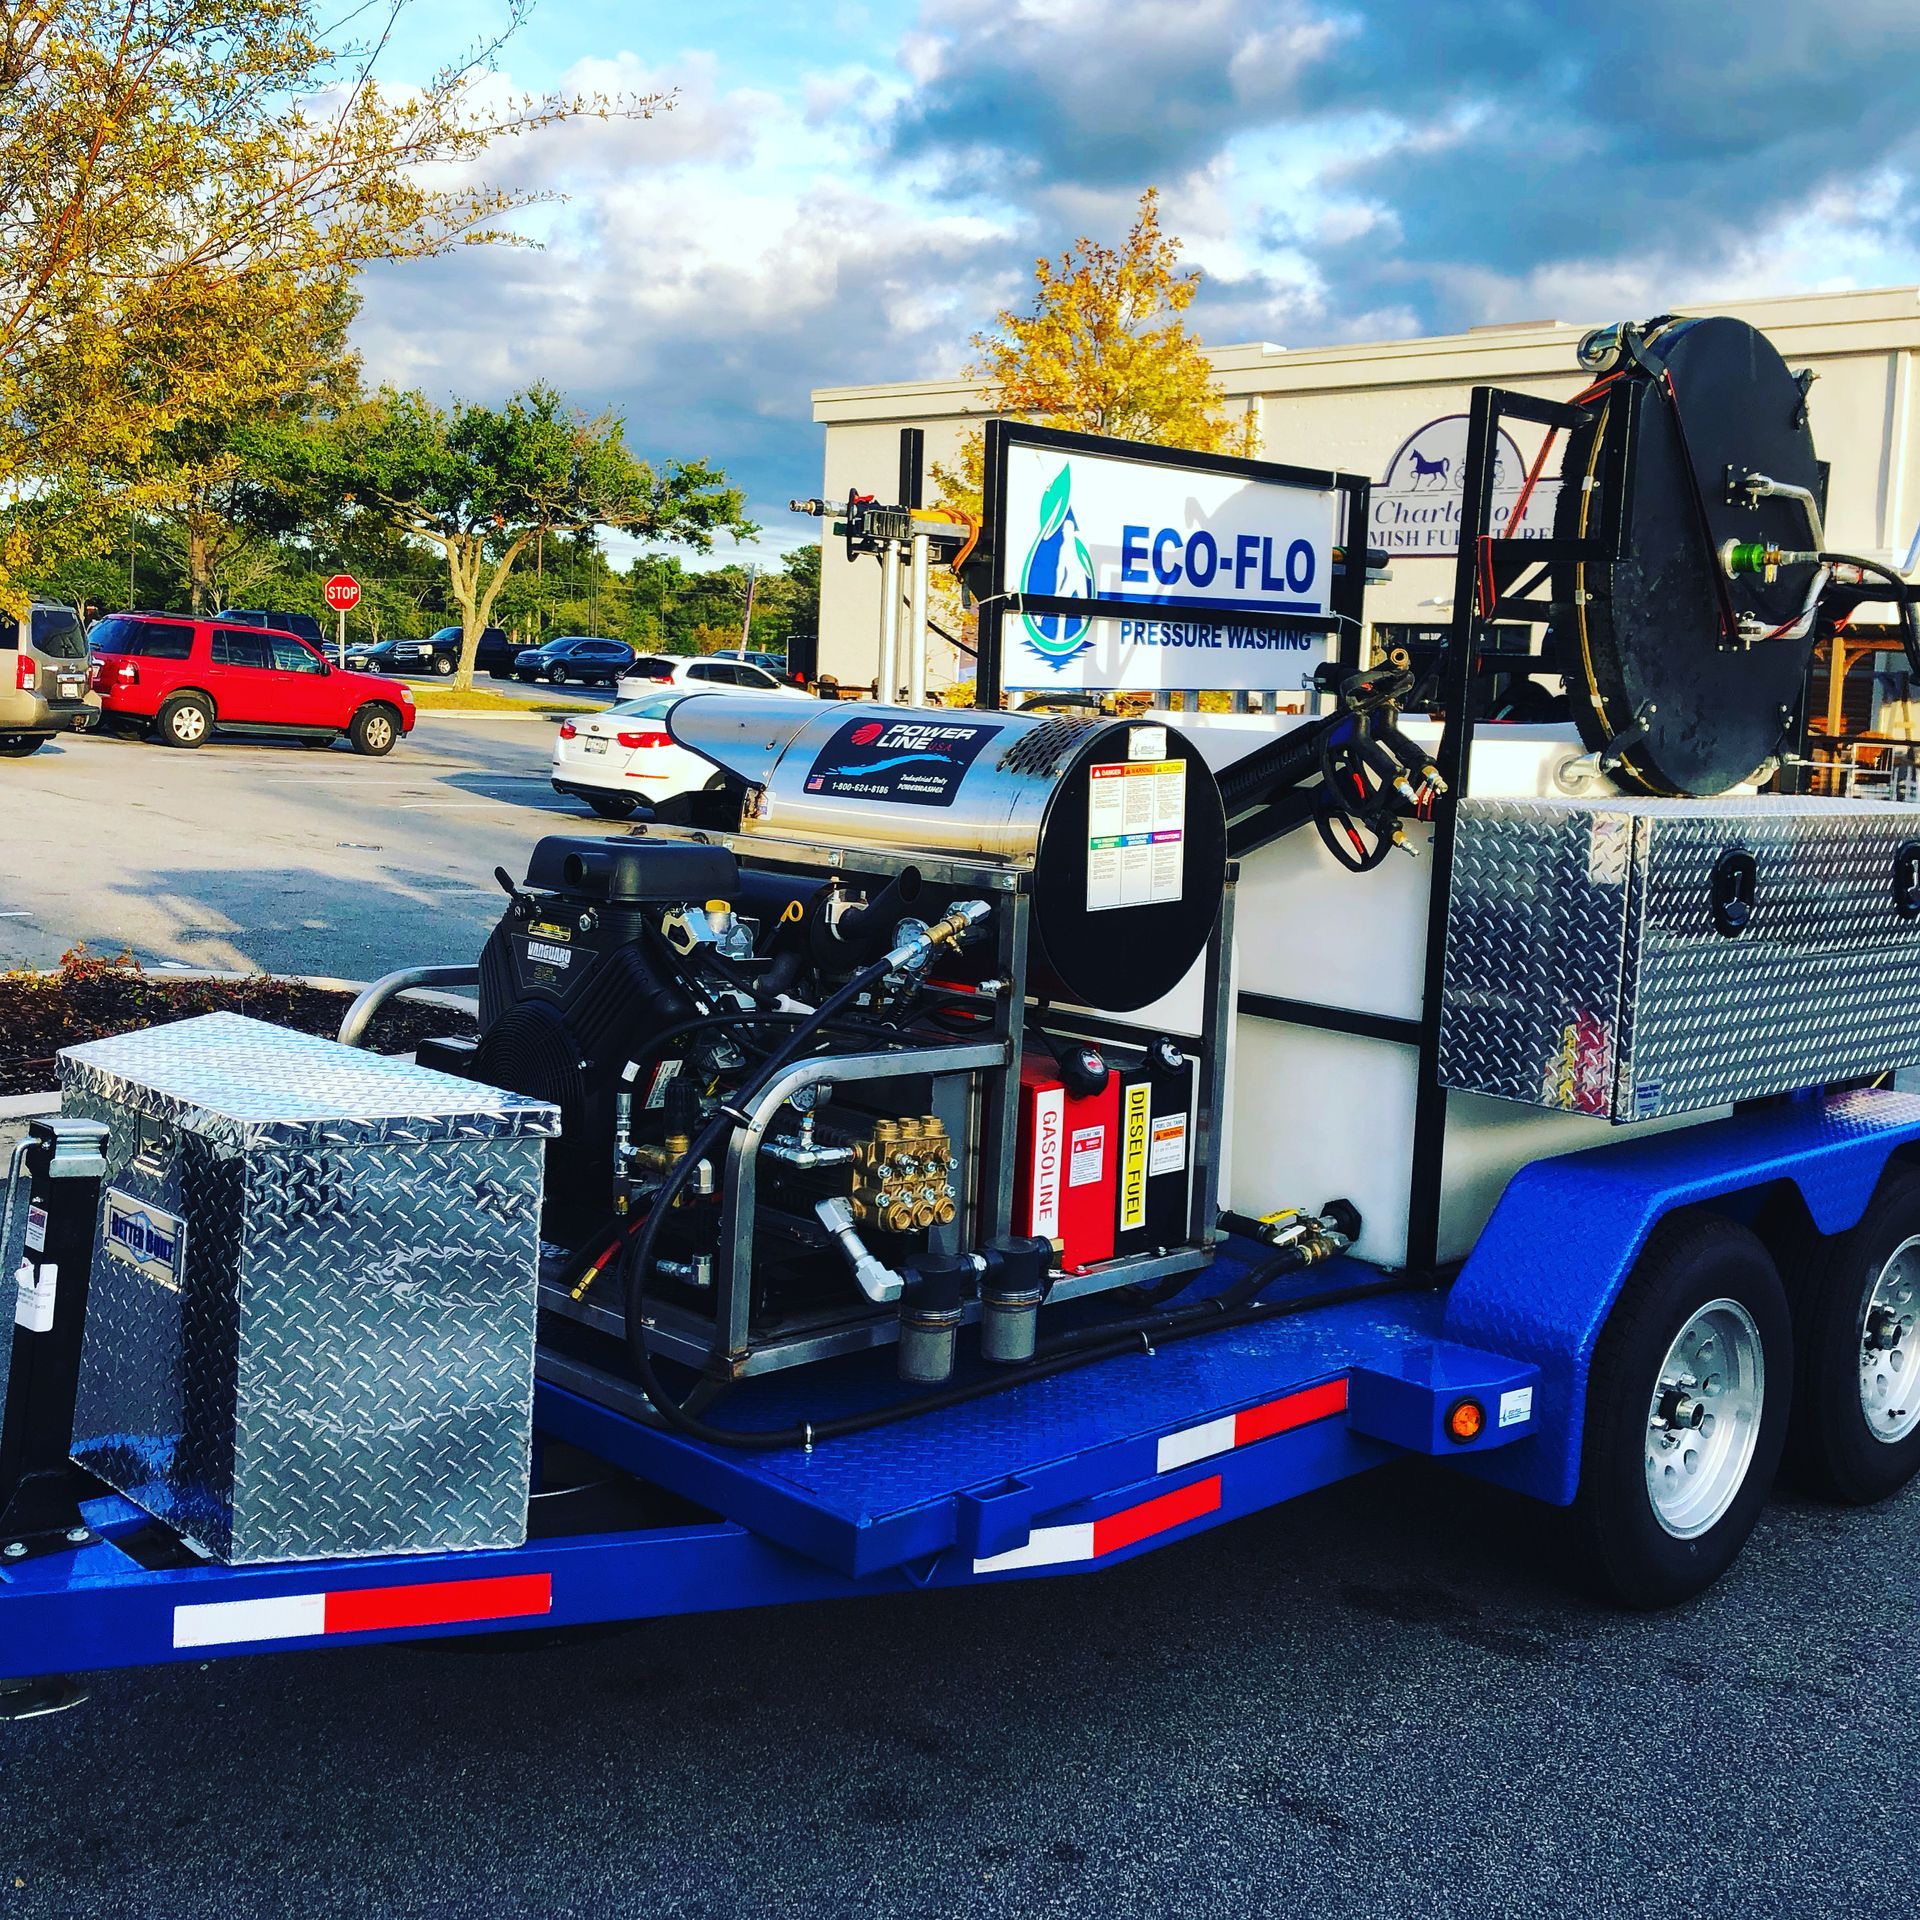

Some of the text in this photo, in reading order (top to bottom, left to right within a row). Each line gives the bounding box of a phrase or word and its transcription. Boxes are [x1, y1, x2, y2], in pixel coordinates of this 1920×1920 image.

[1375, 500, 1528, 524] Charleo
[1368, 530, 1419, 547] MISH
[1121, 525, 1316, 594] ECO-FLO
[328, 586, 358, 600] STOP
[1120, 620, 1312, 651] PRESSURE WASHING
[876, 735, 952, 751] LINE USA
[887, 724, 978, 740] POWER
[832, 782, 889, 794] 1-800-624-8186
[528, 941, 572, 964] VANGUARD
[1038, 1110, 1057, 1221] GASOLINE
[1126, 1090, 1145, 1222] DIESEL FUEL
